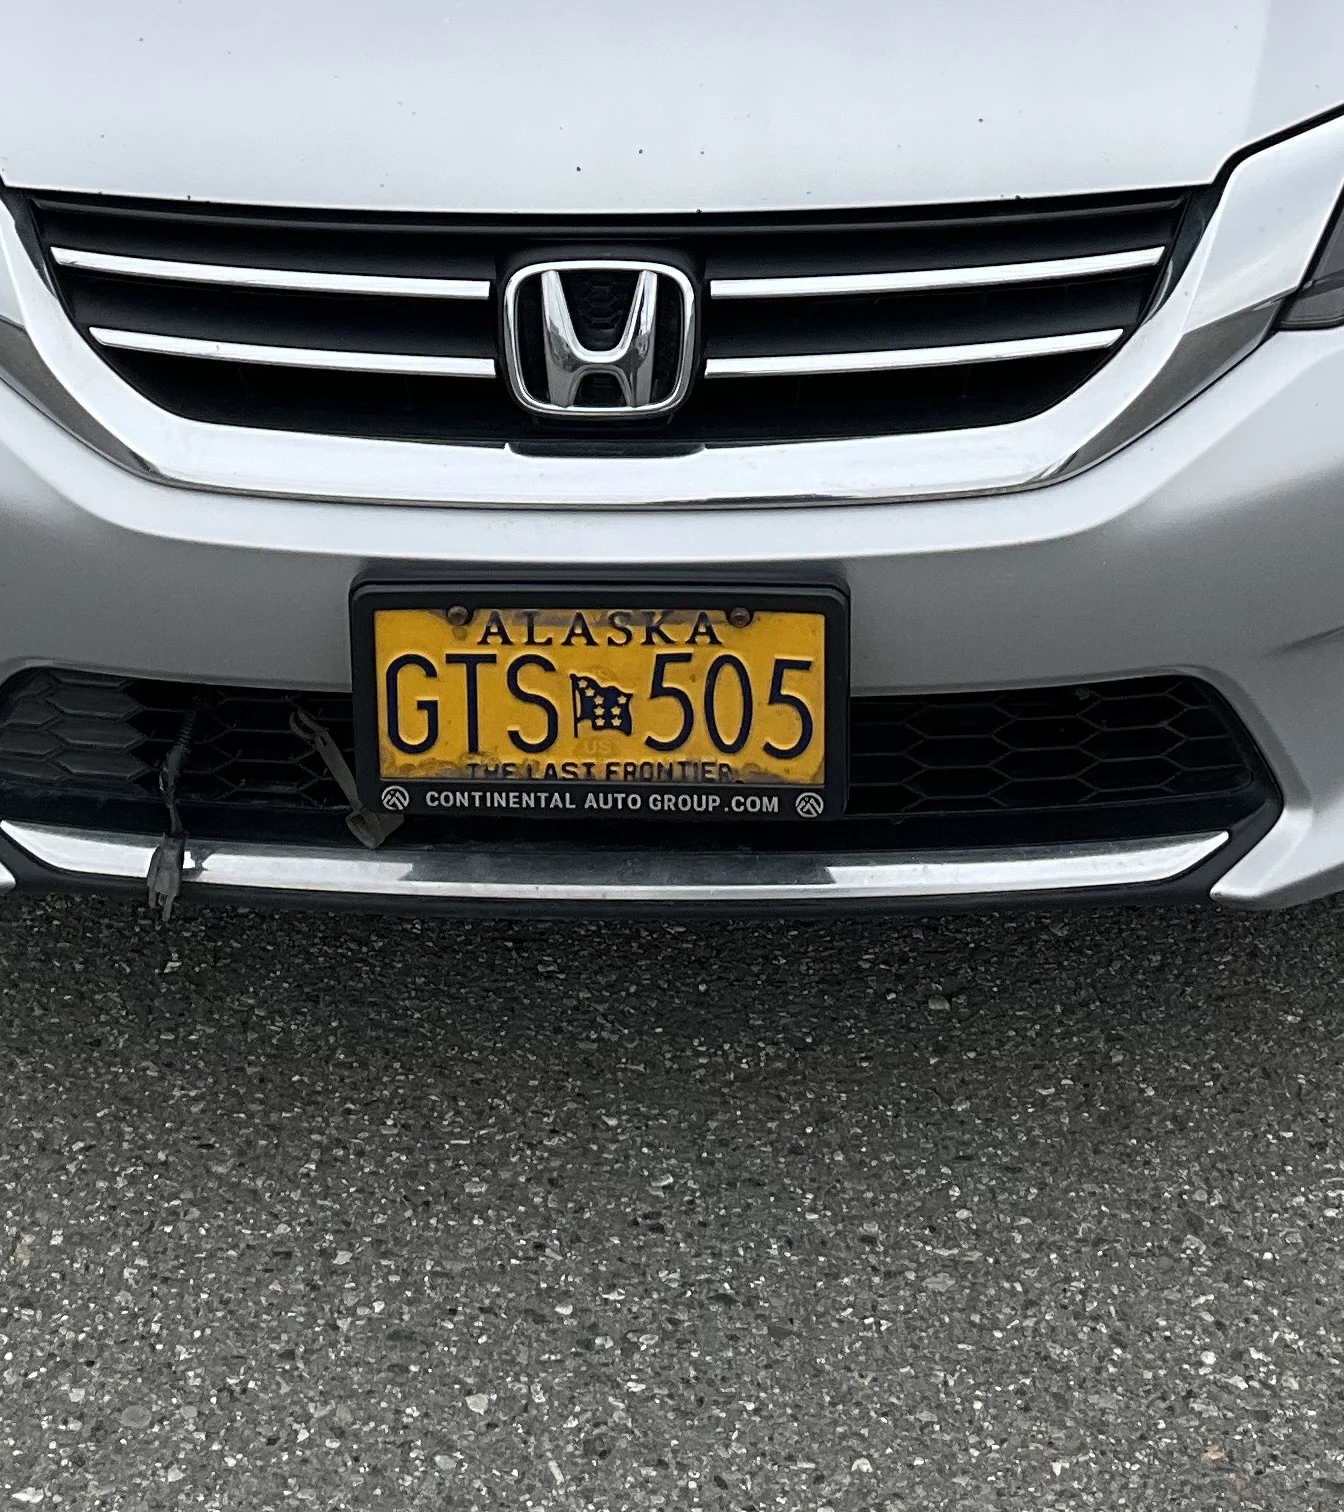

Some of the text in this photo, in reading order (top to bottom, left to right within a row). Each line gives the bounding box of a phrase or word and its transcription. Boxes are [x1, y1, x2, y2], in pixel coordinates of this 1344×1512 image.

[477, 609, 723, 646] ALASKA
[386, 652, 814, 759] GTS 505
[467, 762, 516, 780] THE
[527, 762, 595, 781] LAST
[425, 790, 576, 809] CONTINENTAL
[584, 792, 642, 810] AUTO
